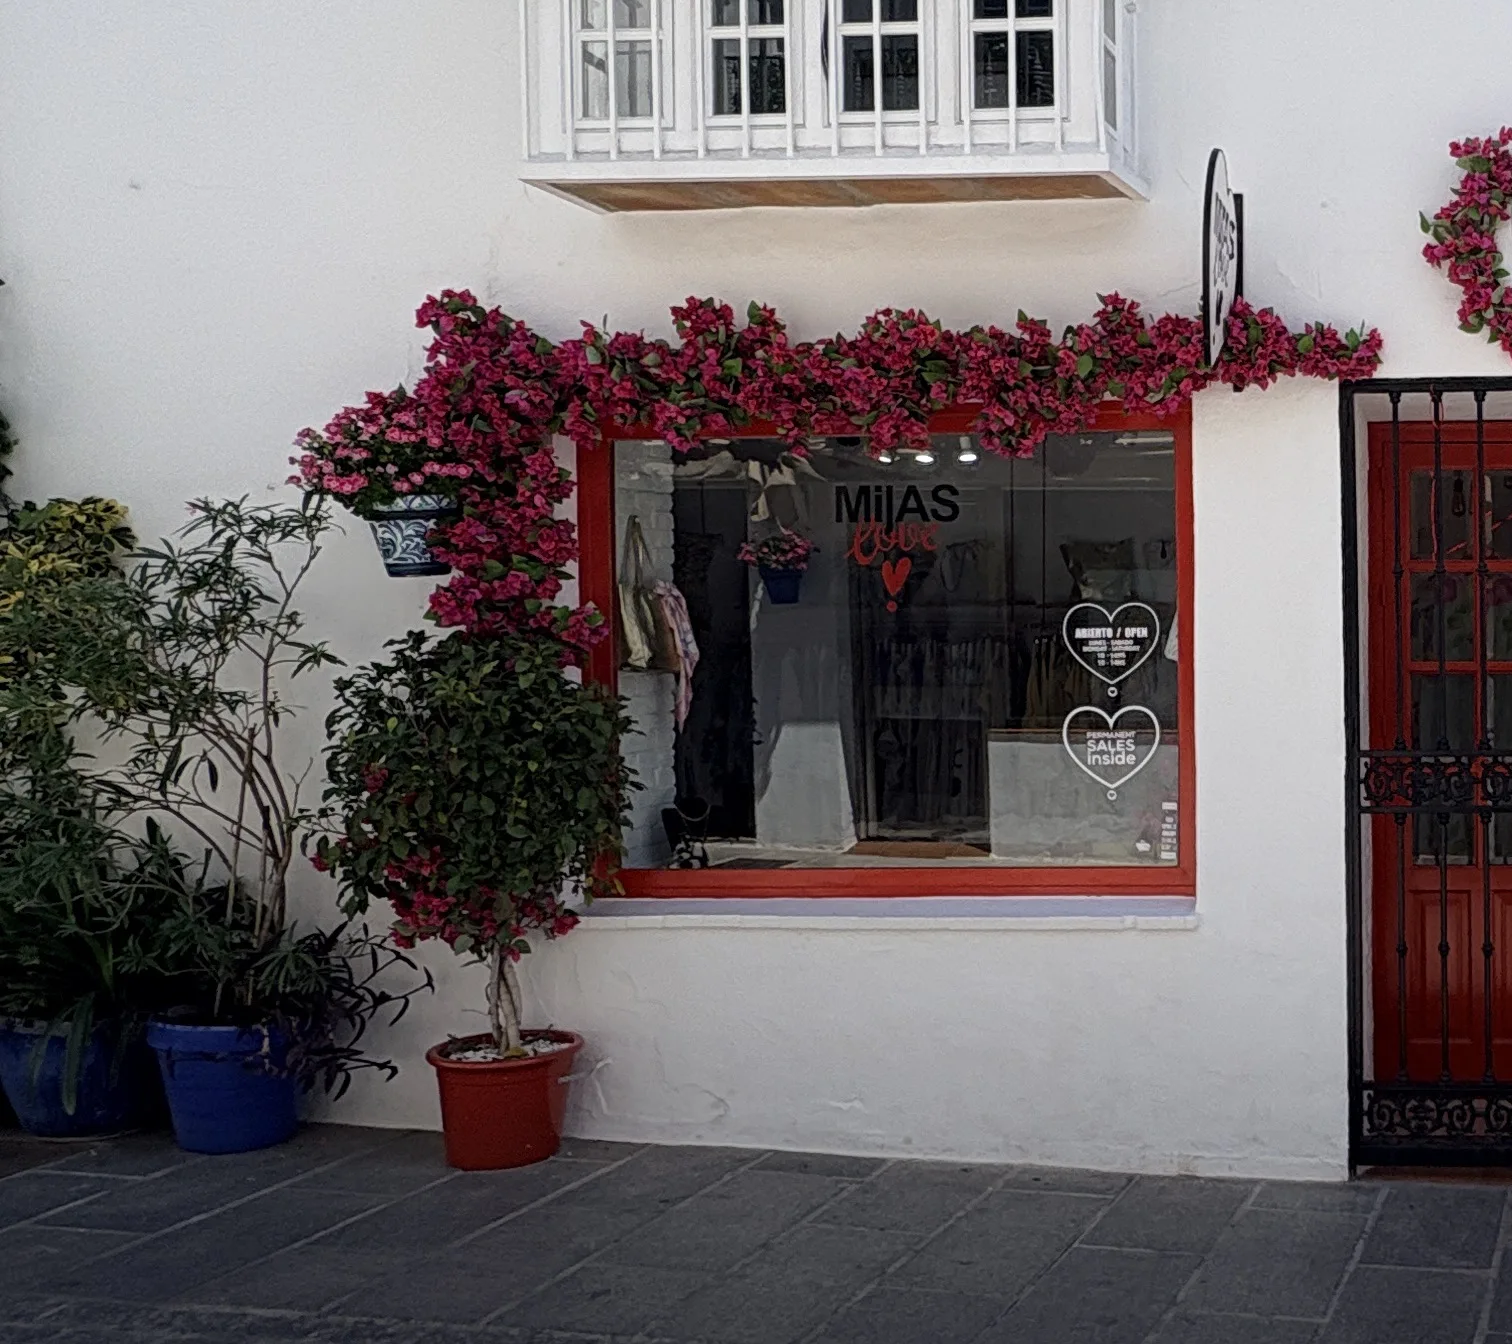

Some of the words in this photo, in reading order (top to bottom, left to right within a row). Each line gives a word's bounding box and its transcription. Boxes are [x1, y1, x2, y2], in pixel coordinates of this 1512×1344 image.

[843, 514, 941, 565] love
[1075, 627, 1113, 639] ABIERTO
[1124, 627, 1148, 638] OPEN
[1086, 731, 1136, 739] PERMANENT
[1086, 739, 1137, 752] SALES
[1087, 749, 1136, 765] inside
